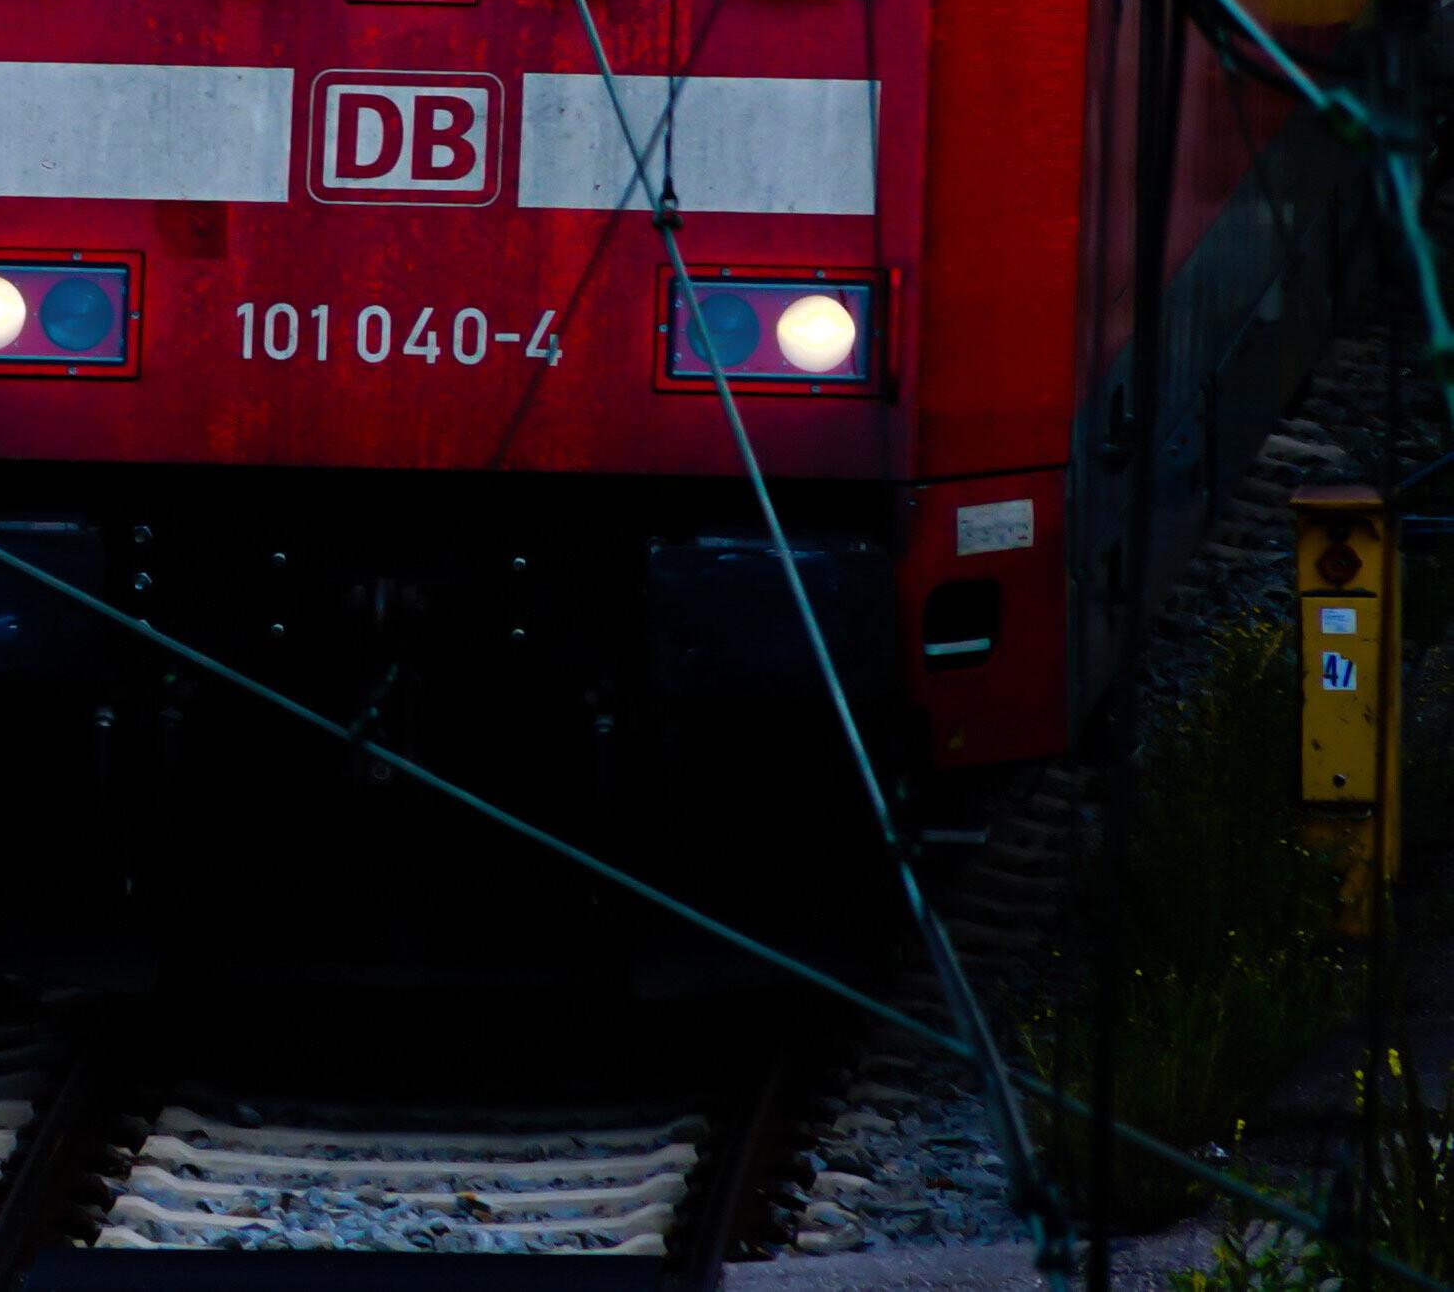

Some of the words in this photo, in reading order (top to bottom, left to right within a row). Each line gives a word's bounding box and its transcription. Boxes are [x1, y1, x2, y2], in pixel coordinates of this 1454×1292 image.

[335, 92, 477, 181] DB
[236, 301, 329, 362] 101
[356, 304, 564, 367] 040-4
